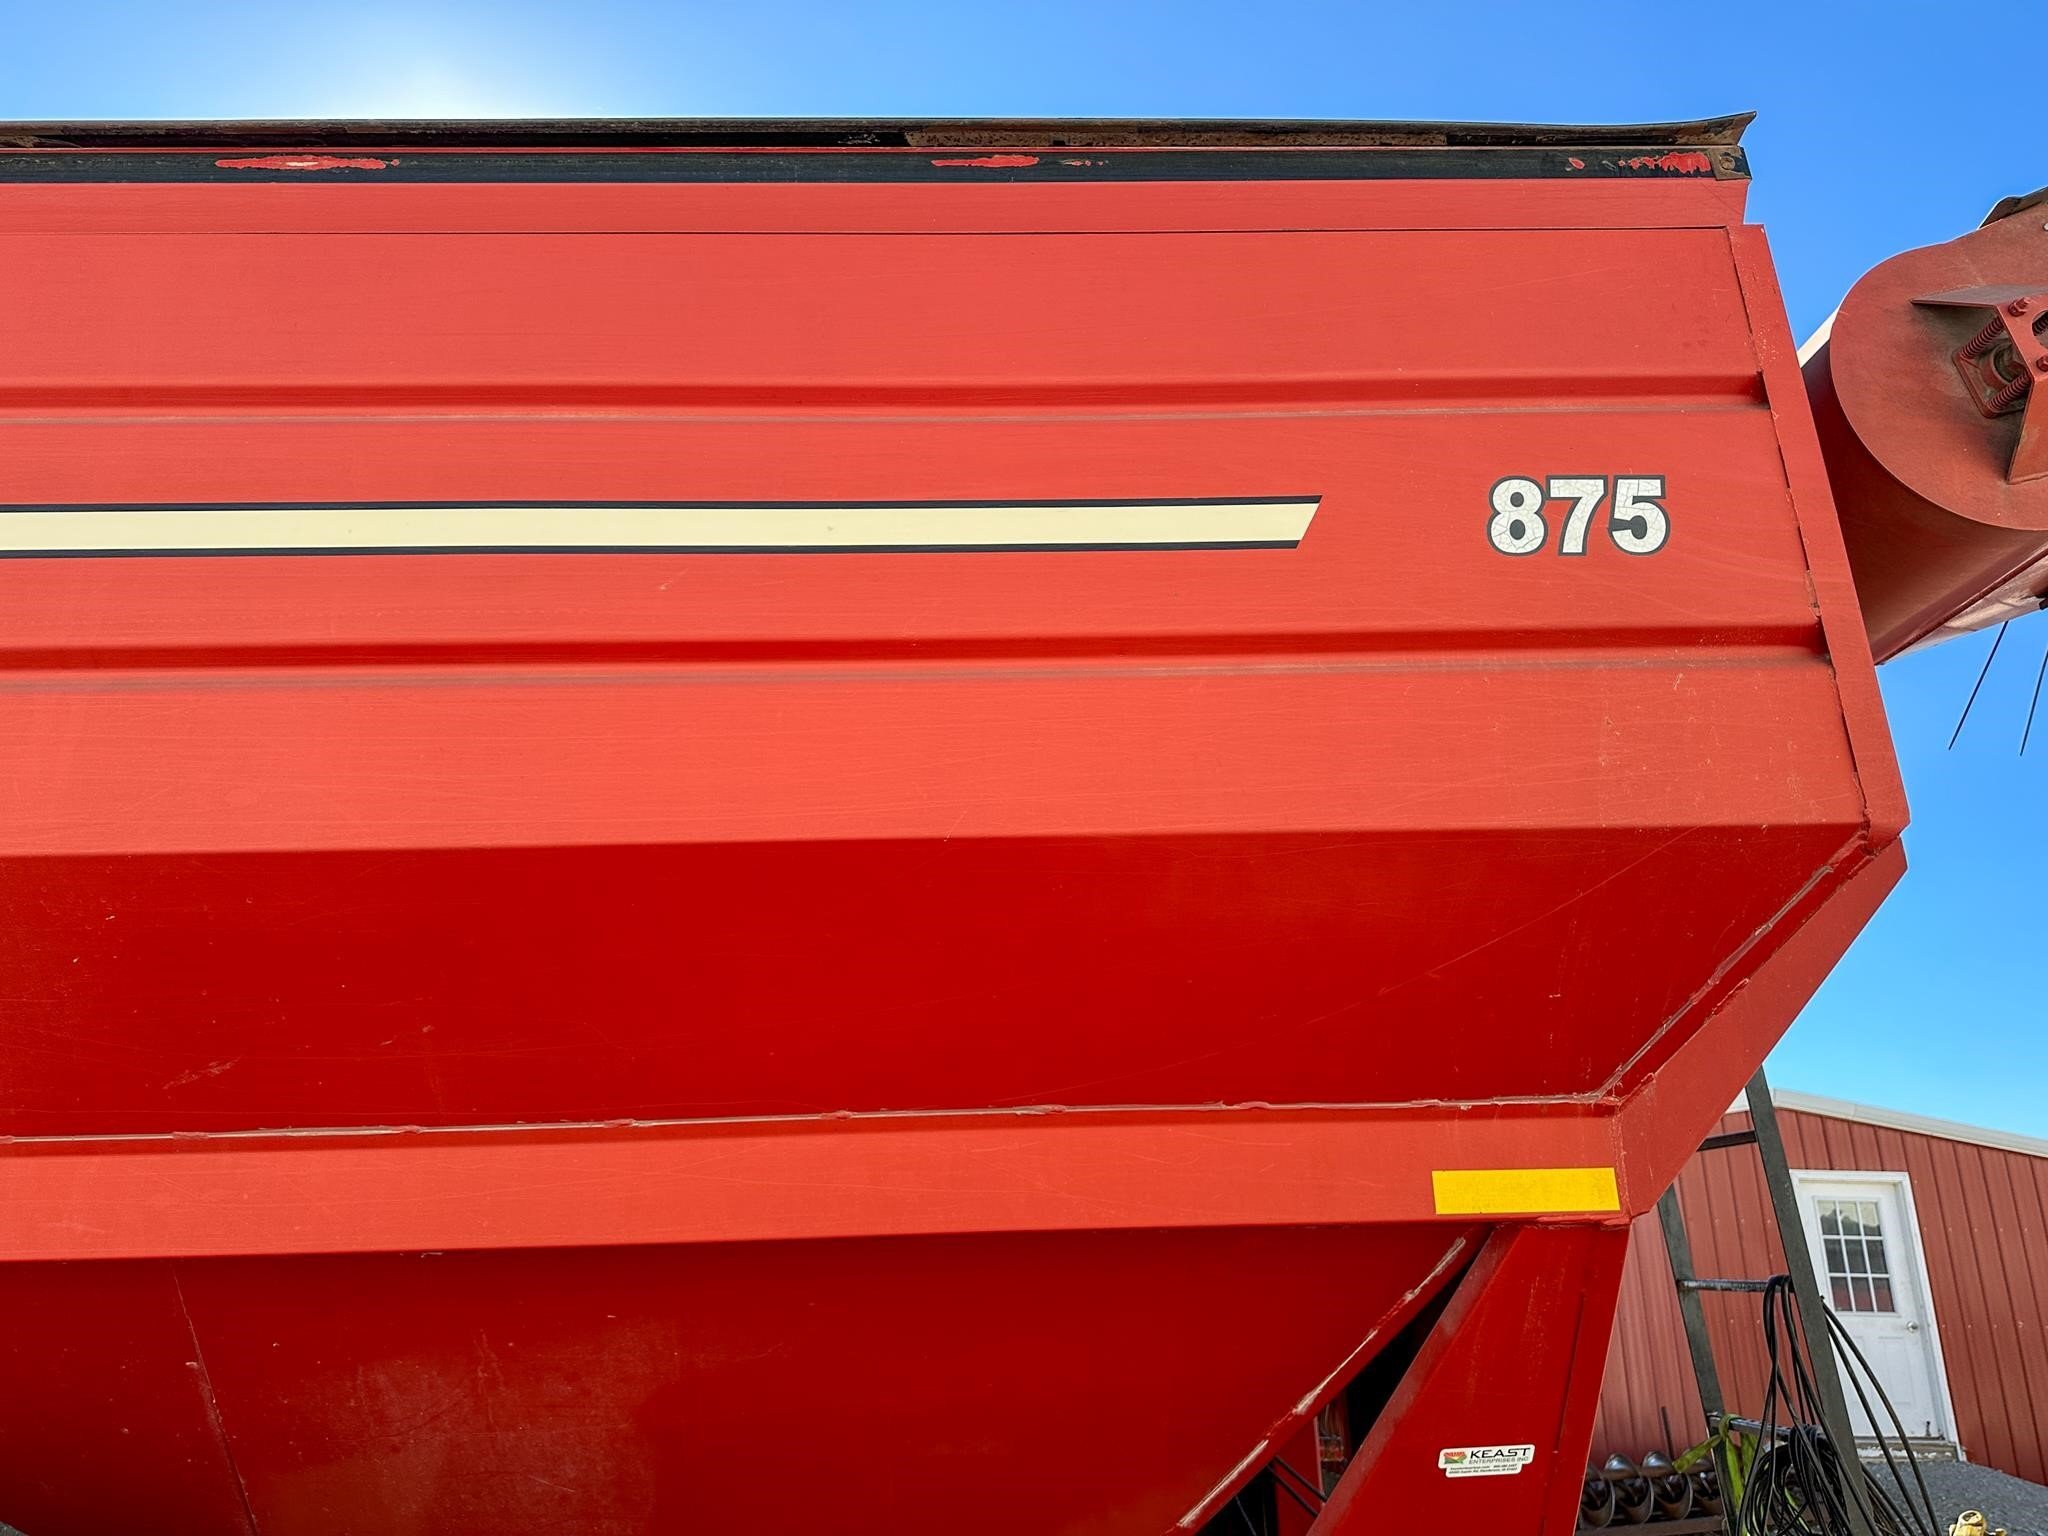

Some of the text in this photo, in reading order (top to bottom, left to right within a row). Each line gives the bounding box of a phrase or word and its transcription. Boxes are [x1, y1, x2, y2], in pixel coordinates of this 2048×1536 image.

[1486, 475, 1671, 557] 875
[1470, 1447, 1531, 1459] KEAST
[1469, 1457, 1515, 1465] ENTERPRISES
